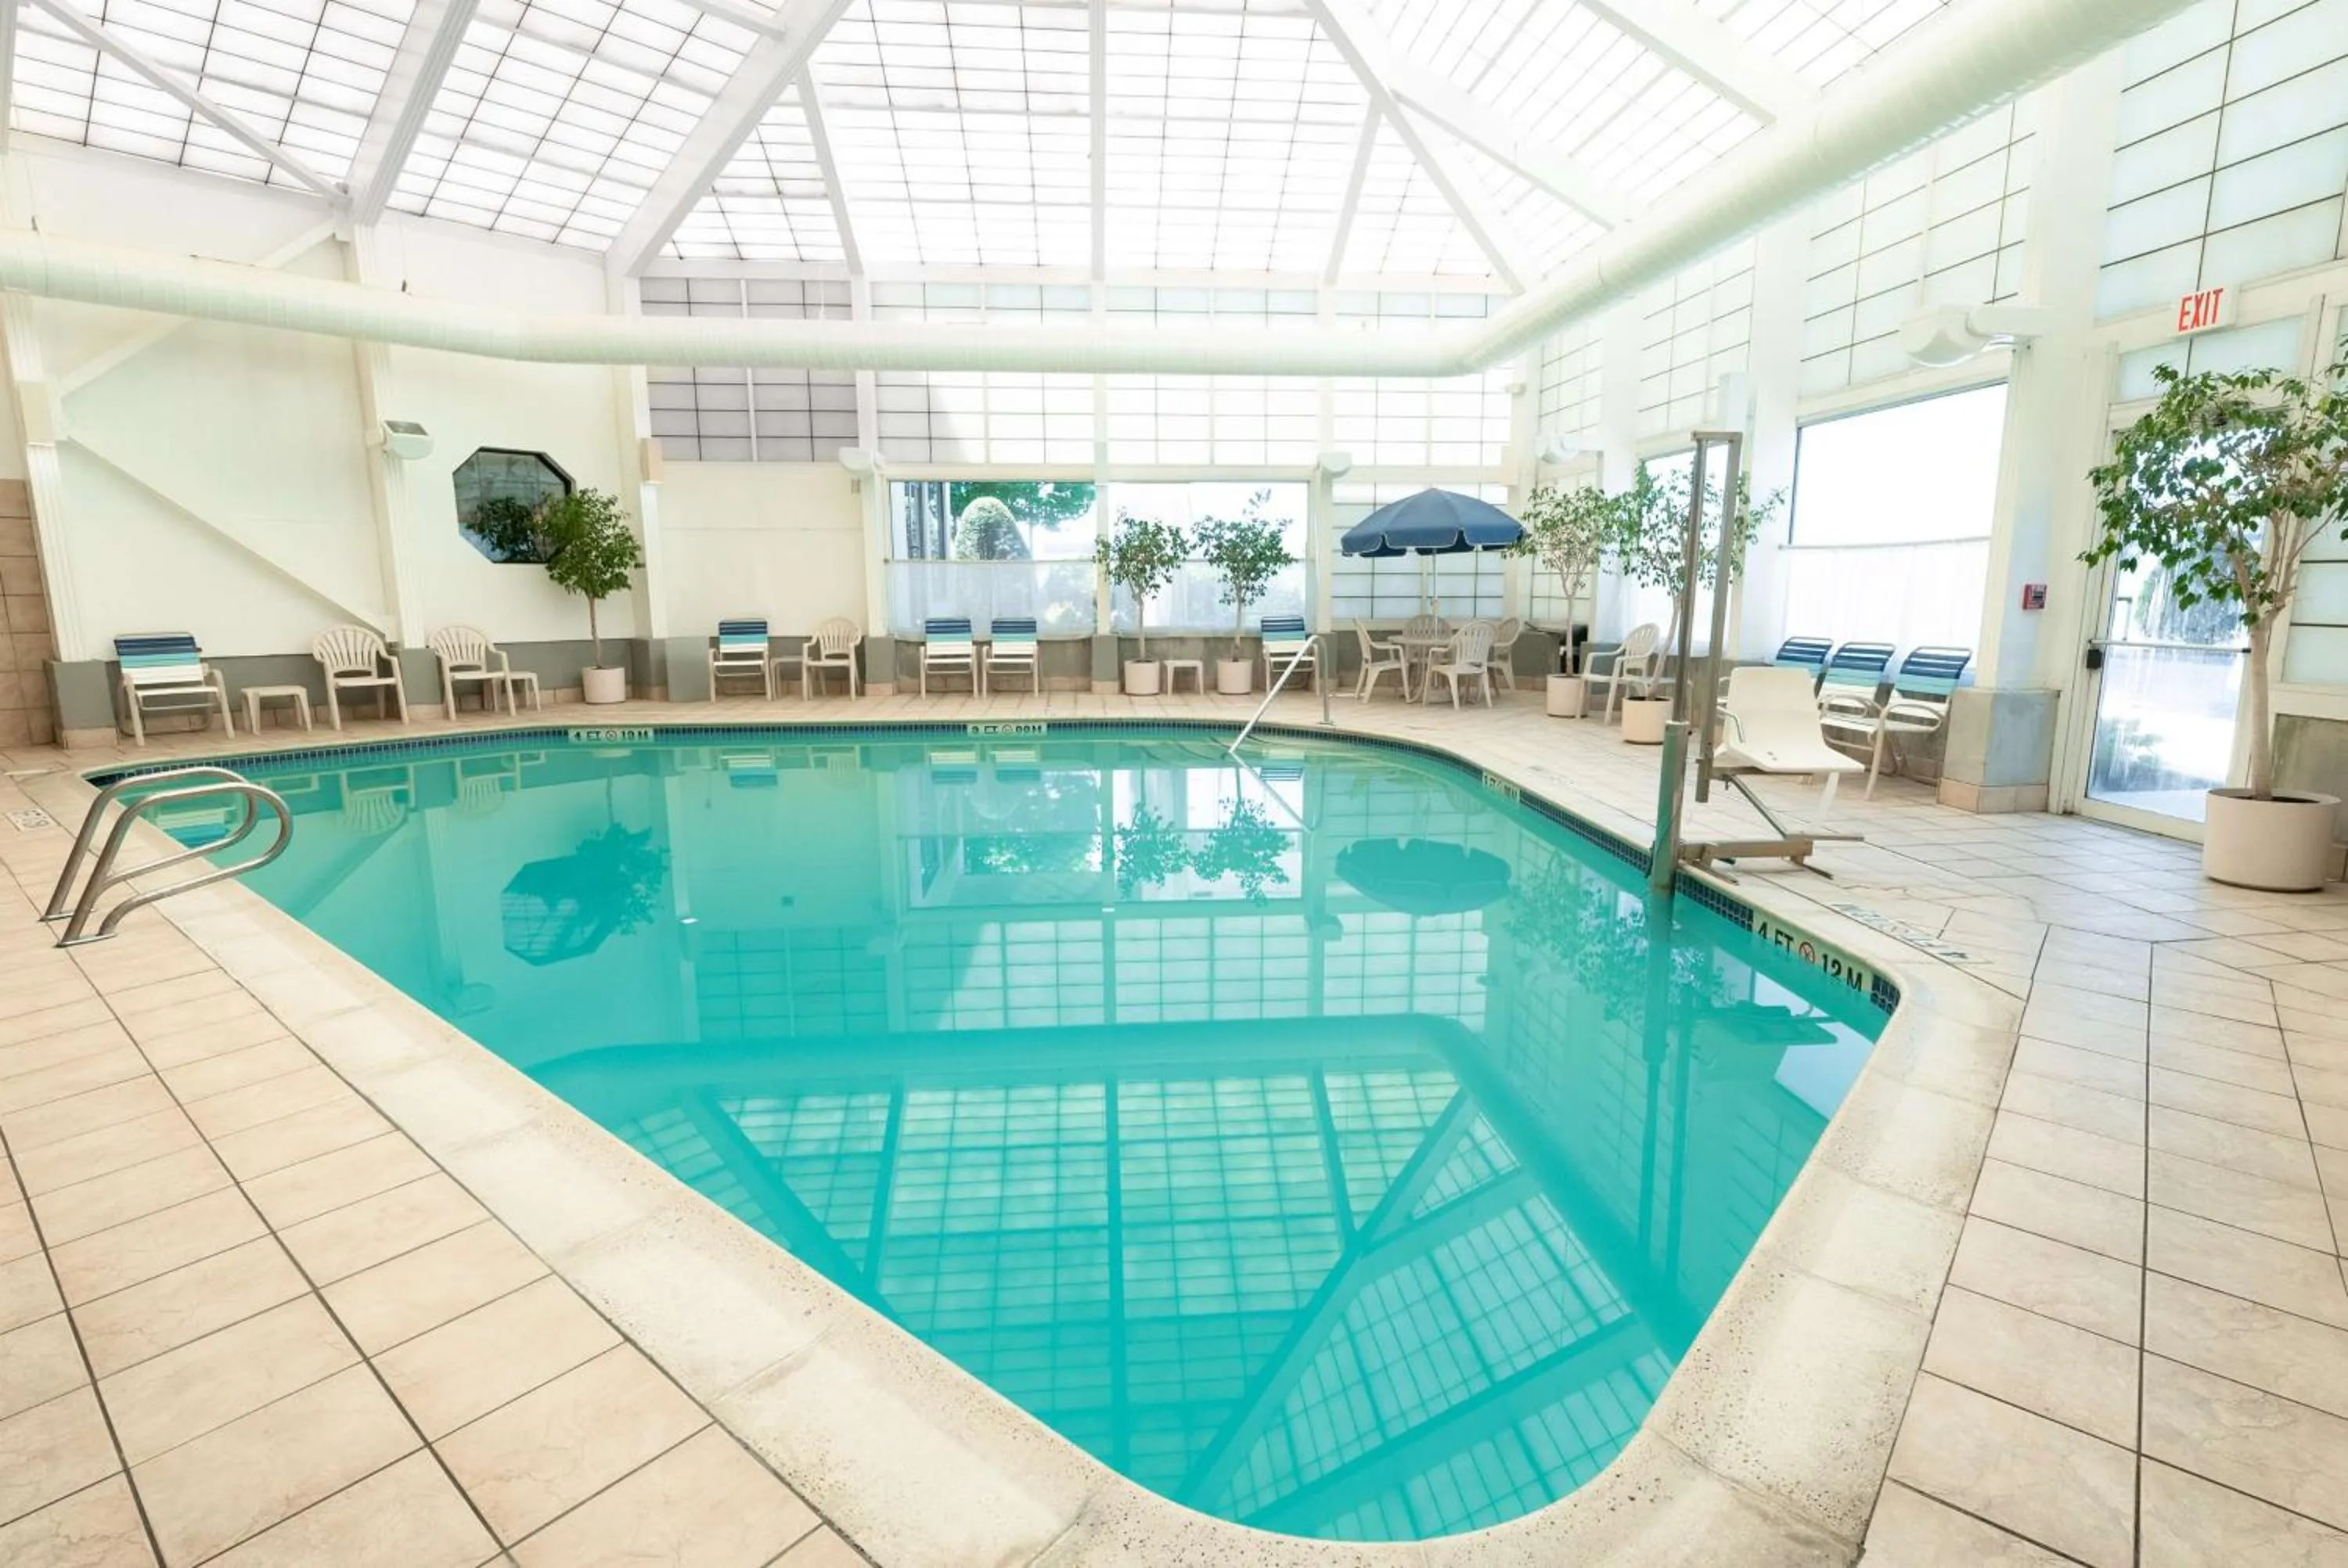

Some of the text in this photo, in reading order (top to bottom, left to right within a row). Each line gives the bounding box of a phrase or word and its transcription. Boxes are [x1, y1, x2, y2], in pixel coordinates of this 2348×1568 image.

[2177, 287, 2224, 332] EXIT
[1758, 922, 1767, 940] 4
[1774, 928, 1794, 952] FT
